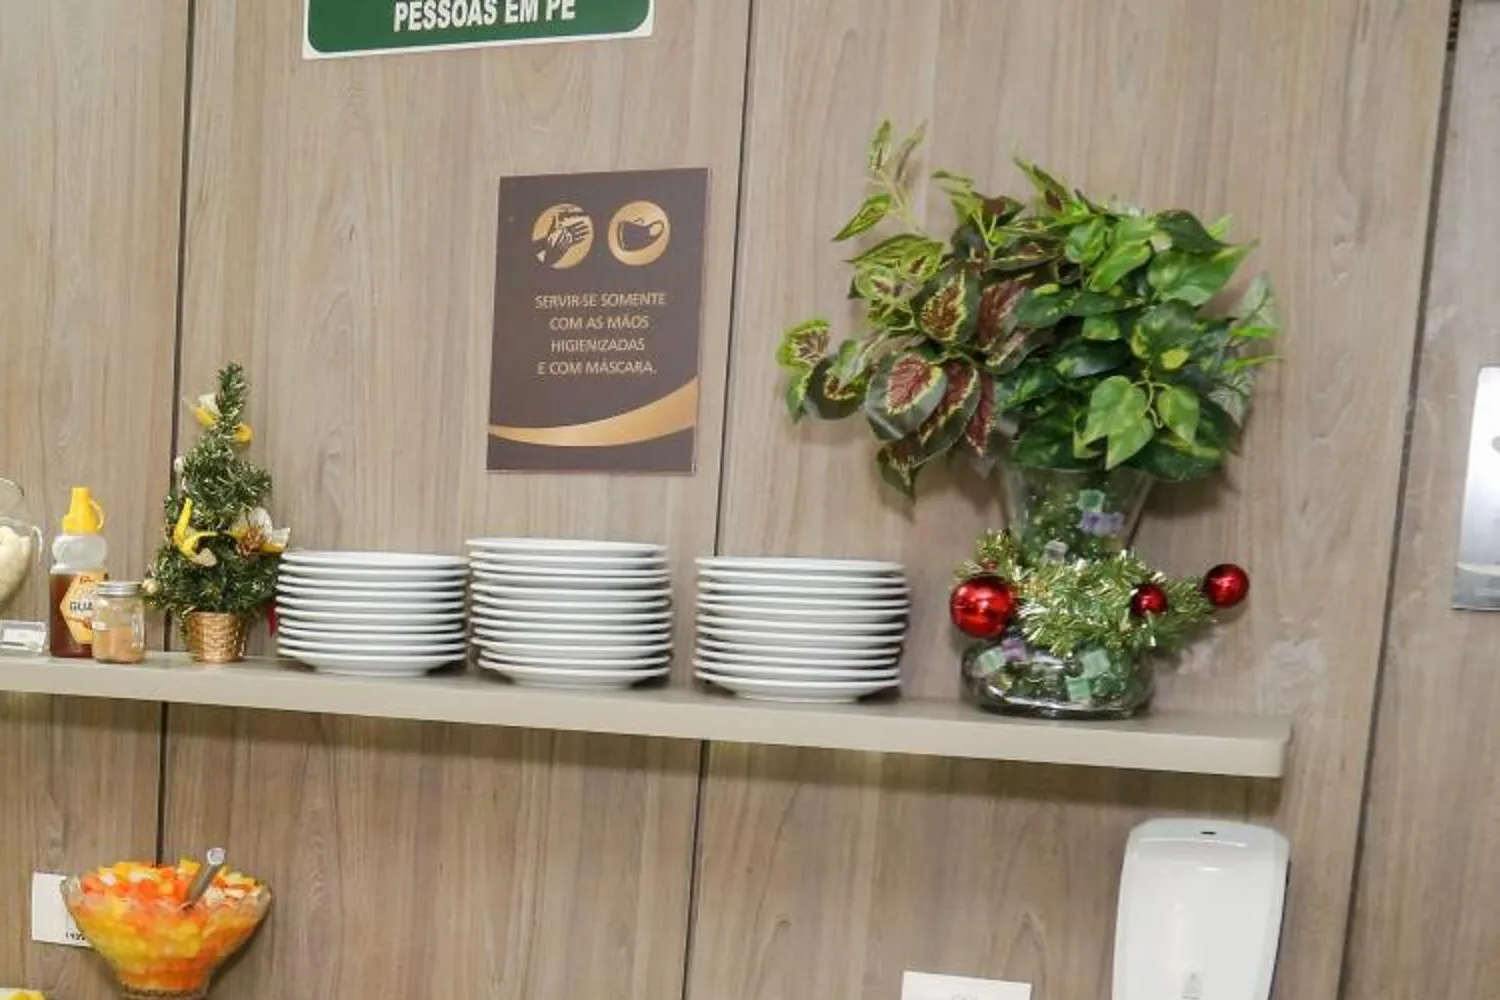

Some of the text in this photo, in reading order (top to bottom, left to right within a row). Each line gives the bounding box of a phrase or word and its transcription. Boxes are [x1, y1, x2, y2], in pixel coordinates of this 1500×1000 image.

[393, 0, 498, 32] PESSOAS
[505, 0, 538, 23] EM
[601, 292, 667, 307] SOMENTE
[549, 316, 583, 331] COM
[586, 316, 603, 330] AS
[551, 338, 646, 353] HIGIENIZADAS
[537, 361, 547, 375] E
[549, 360, 581, 375] COM
